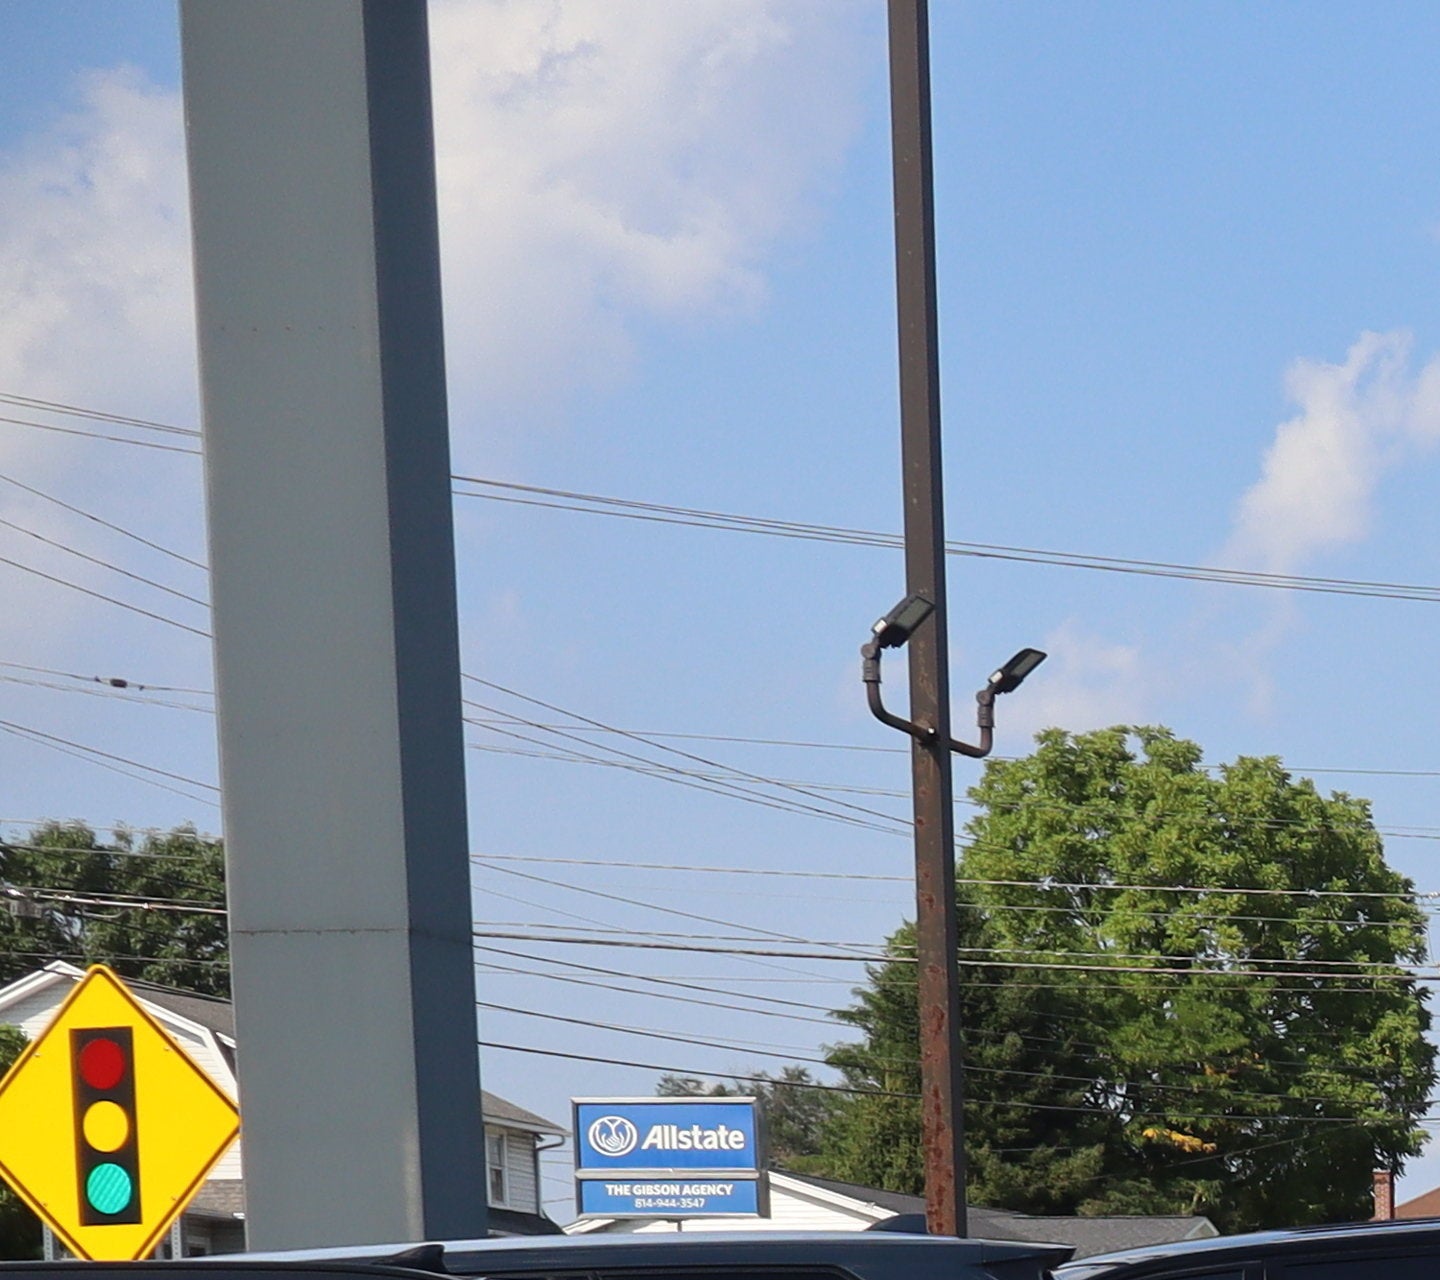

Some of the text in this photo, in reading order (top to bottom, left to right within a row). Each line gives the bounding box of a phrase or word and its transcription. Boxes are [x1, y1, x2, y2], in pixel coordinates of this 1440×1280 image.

[641, 1124, 746, 1150] Allstate
[605, 1184, 734, 1196] THE GIBSON AGENCY
[634, 1198, 706, 1209] 814-944-3547
